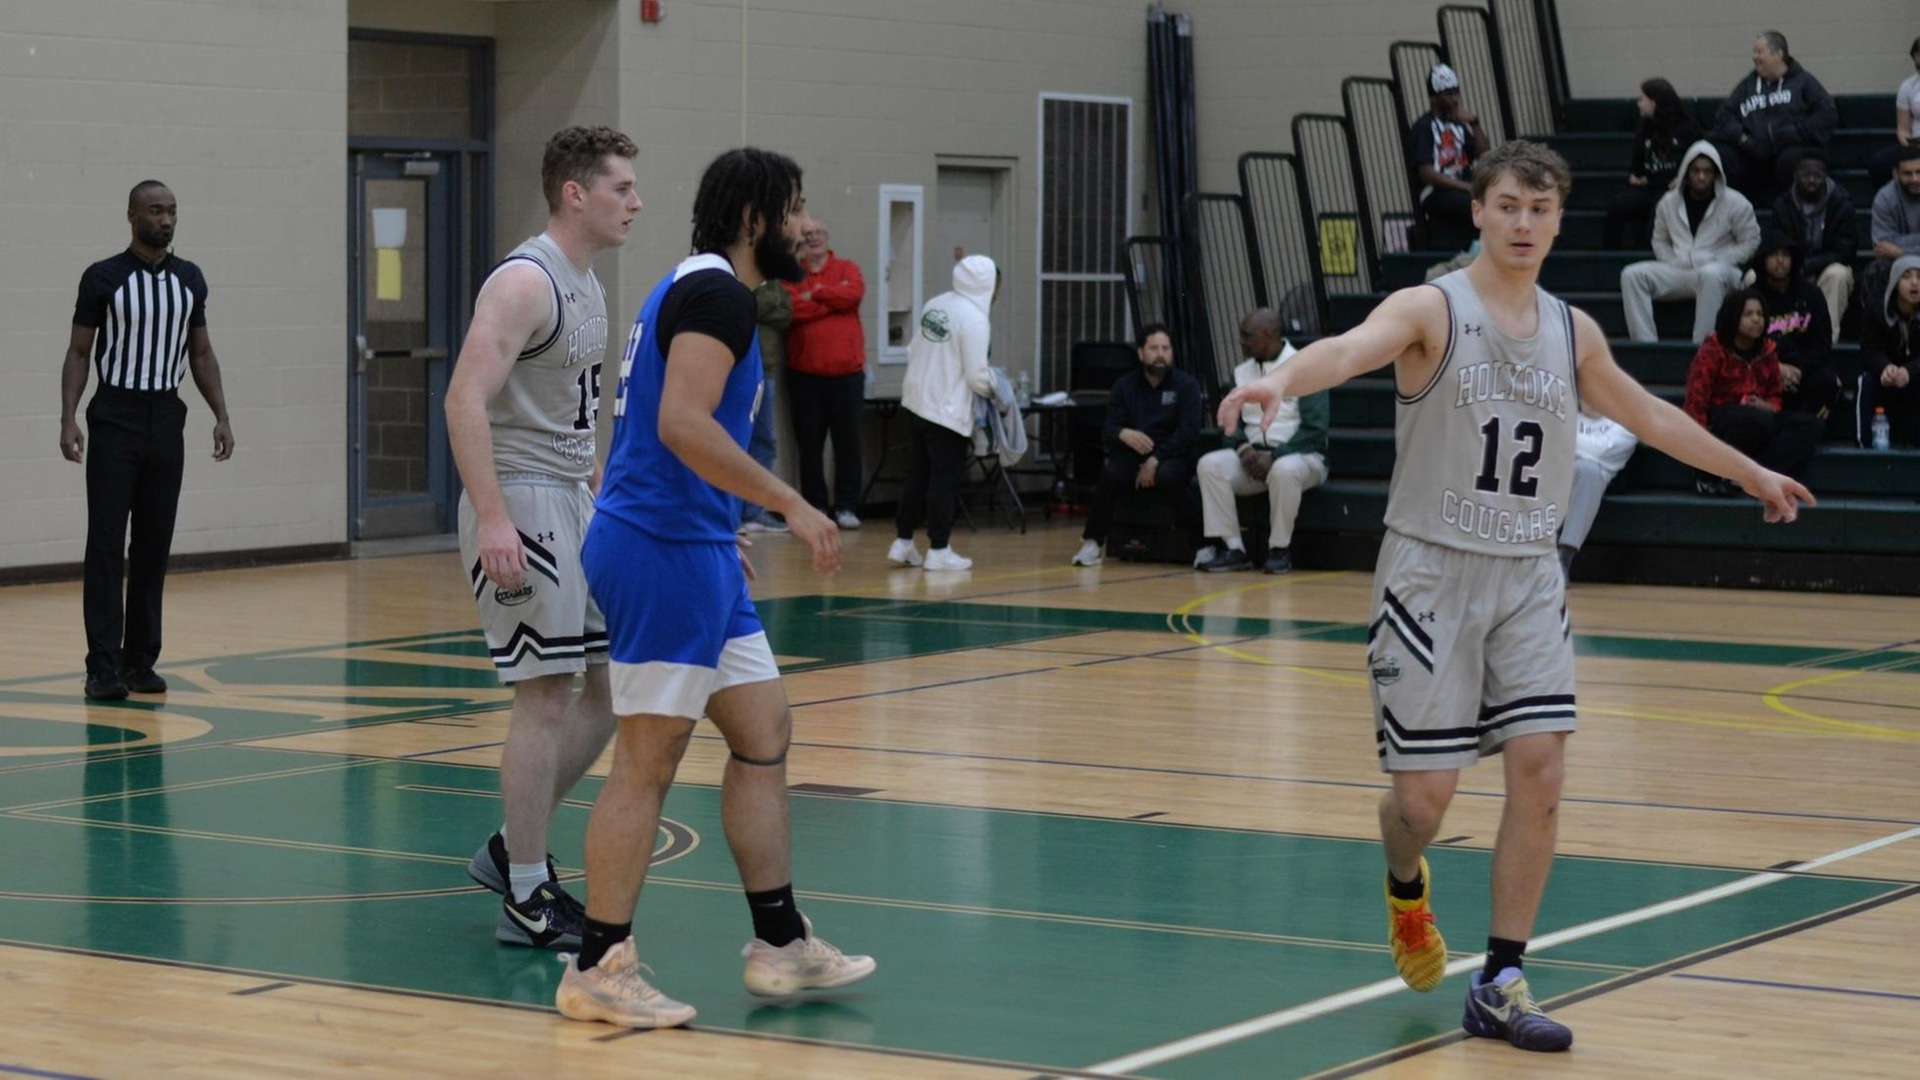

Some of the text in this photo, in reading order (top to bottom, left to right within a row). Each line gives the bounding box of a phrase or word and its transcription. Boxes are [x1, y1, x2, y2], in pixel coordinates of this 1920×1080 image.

[1455, 361, 1567, 424] HOLYOKE
[1473, 414, 1545, 500] 12
[1440, 488, 1559, 545] COUGARS
